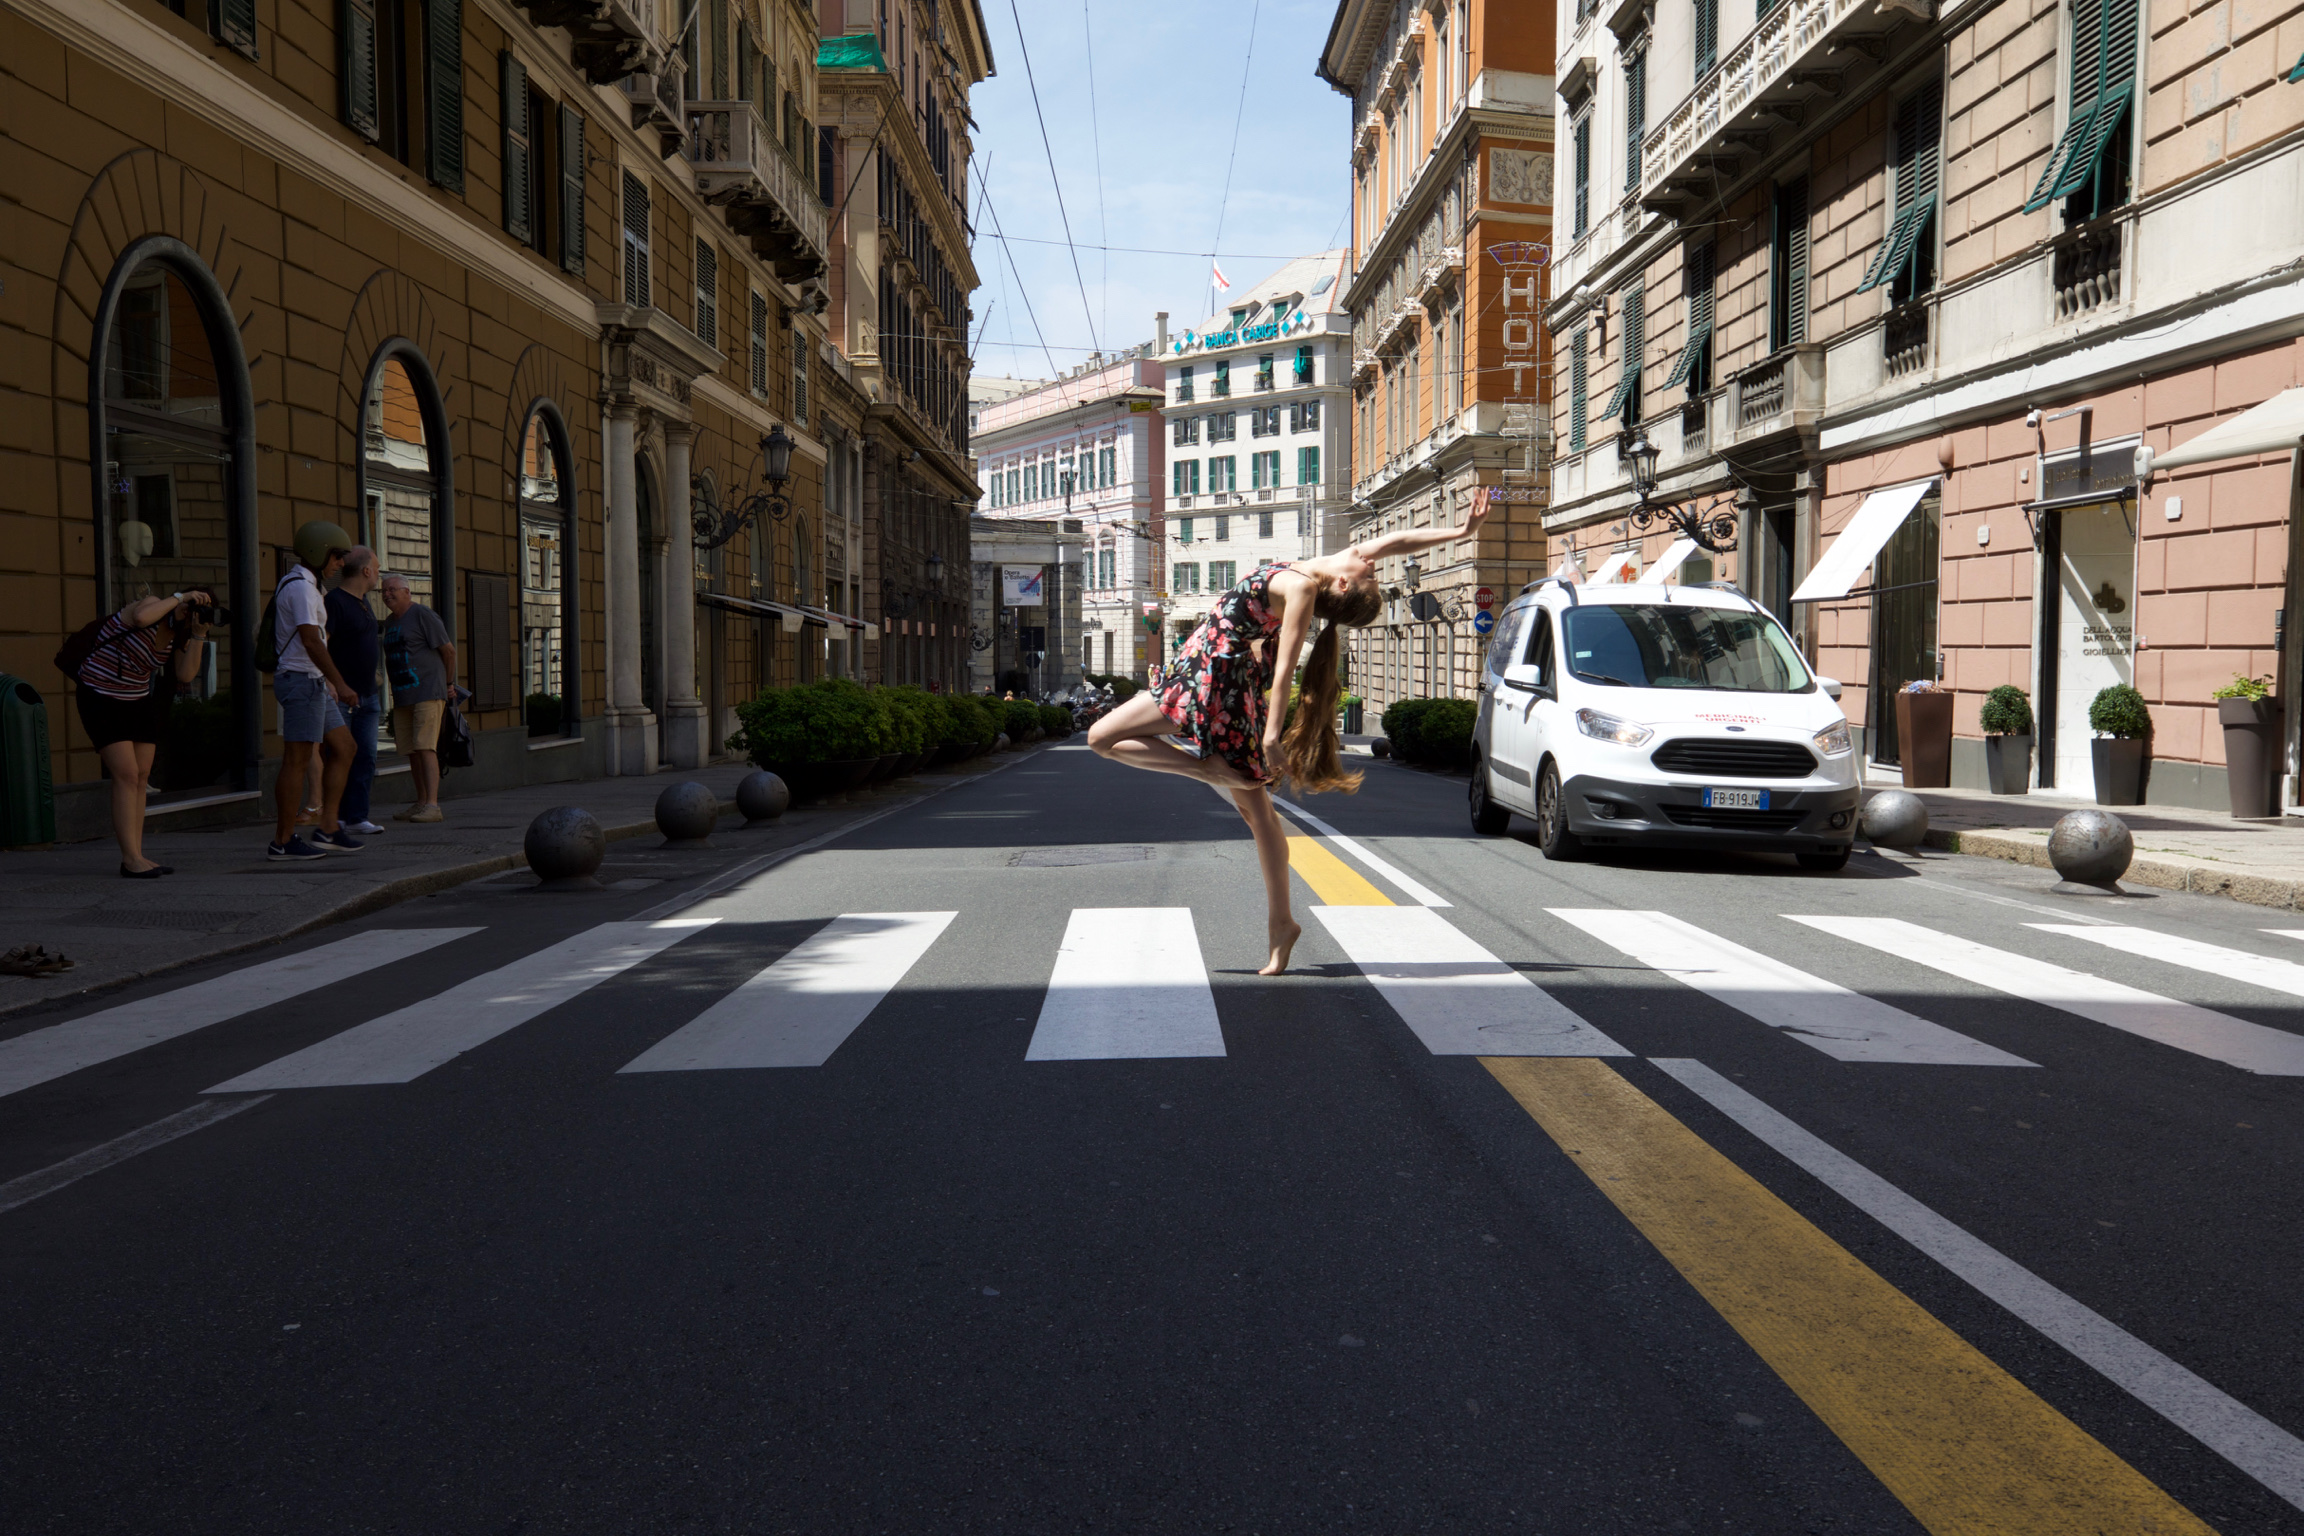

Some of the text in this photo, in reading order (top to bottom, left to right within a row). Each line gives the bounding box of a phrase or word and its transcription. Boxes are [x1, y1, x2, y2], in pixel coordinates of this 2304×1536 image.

[1205, 322, 1278, 348] BANCA CARIGE
[1004, 569, 1020, 577] Opera
[1476, 594, 1494, 603] STOP
[2083, 634, 2132, 643] BARTOLONE
[1695, 713, 1766, 721] MEDICINALI
